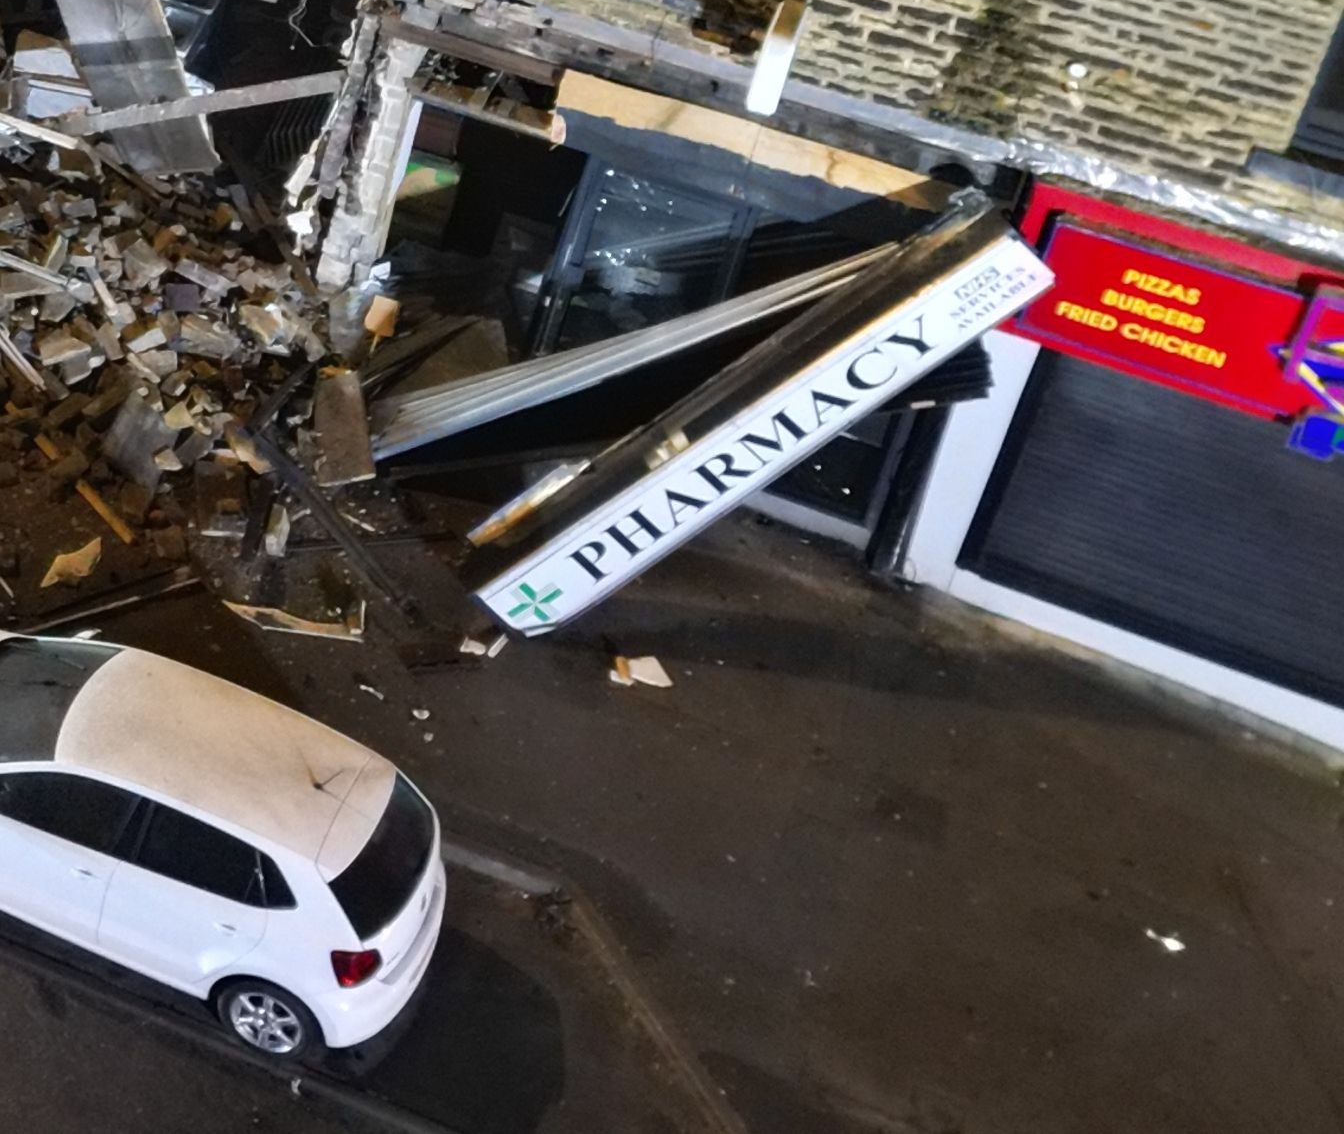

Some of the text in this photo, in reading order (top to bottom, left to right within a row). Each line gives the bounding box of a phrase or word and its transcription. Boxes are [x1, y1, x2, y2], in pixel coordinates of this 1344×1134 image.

[949, 266, 1027, 317] SERVICES
[958, 273, 1037, 329] AVAILABLE
[1100, 288, 1206, 334] BURGERS
[1121, 268, 1203, 306] PIZZAS
[1055, 300, 1228, 369] FRIED CHICKEN
[566, 313, 940, 585] PHARMACY
